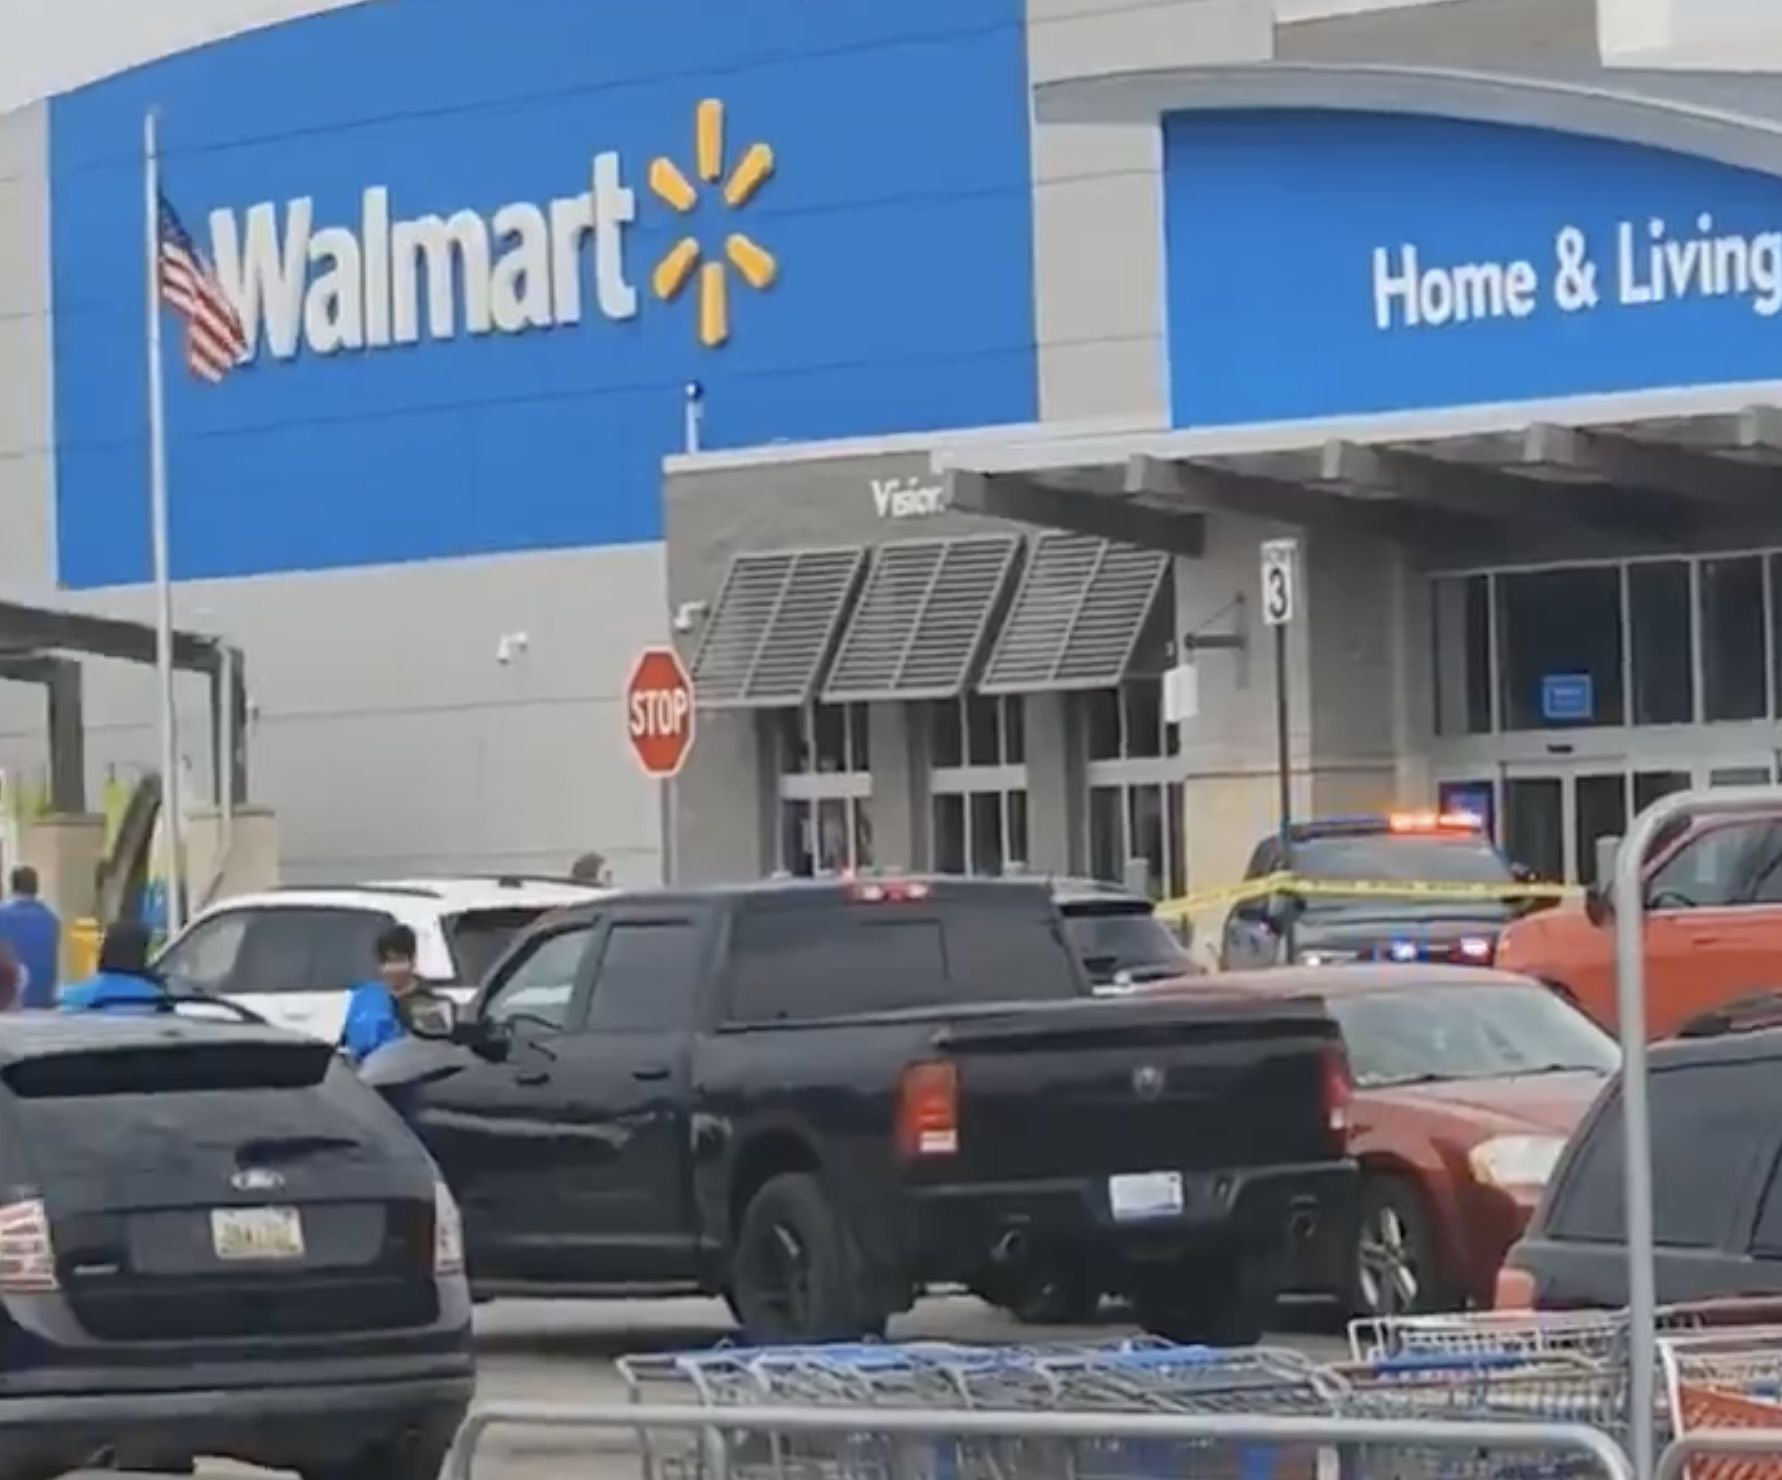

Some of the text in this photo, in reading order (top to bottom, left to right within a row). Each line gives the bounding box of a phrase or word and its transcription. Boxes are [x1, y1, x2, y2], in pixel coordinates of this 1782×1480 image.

[210, 150, 637, 366] Walmart
[1373, 211, 1782, 330] Home & Living
[1269, 567, 1288, 619] 3
[631, 688, 688, 736] STOP
